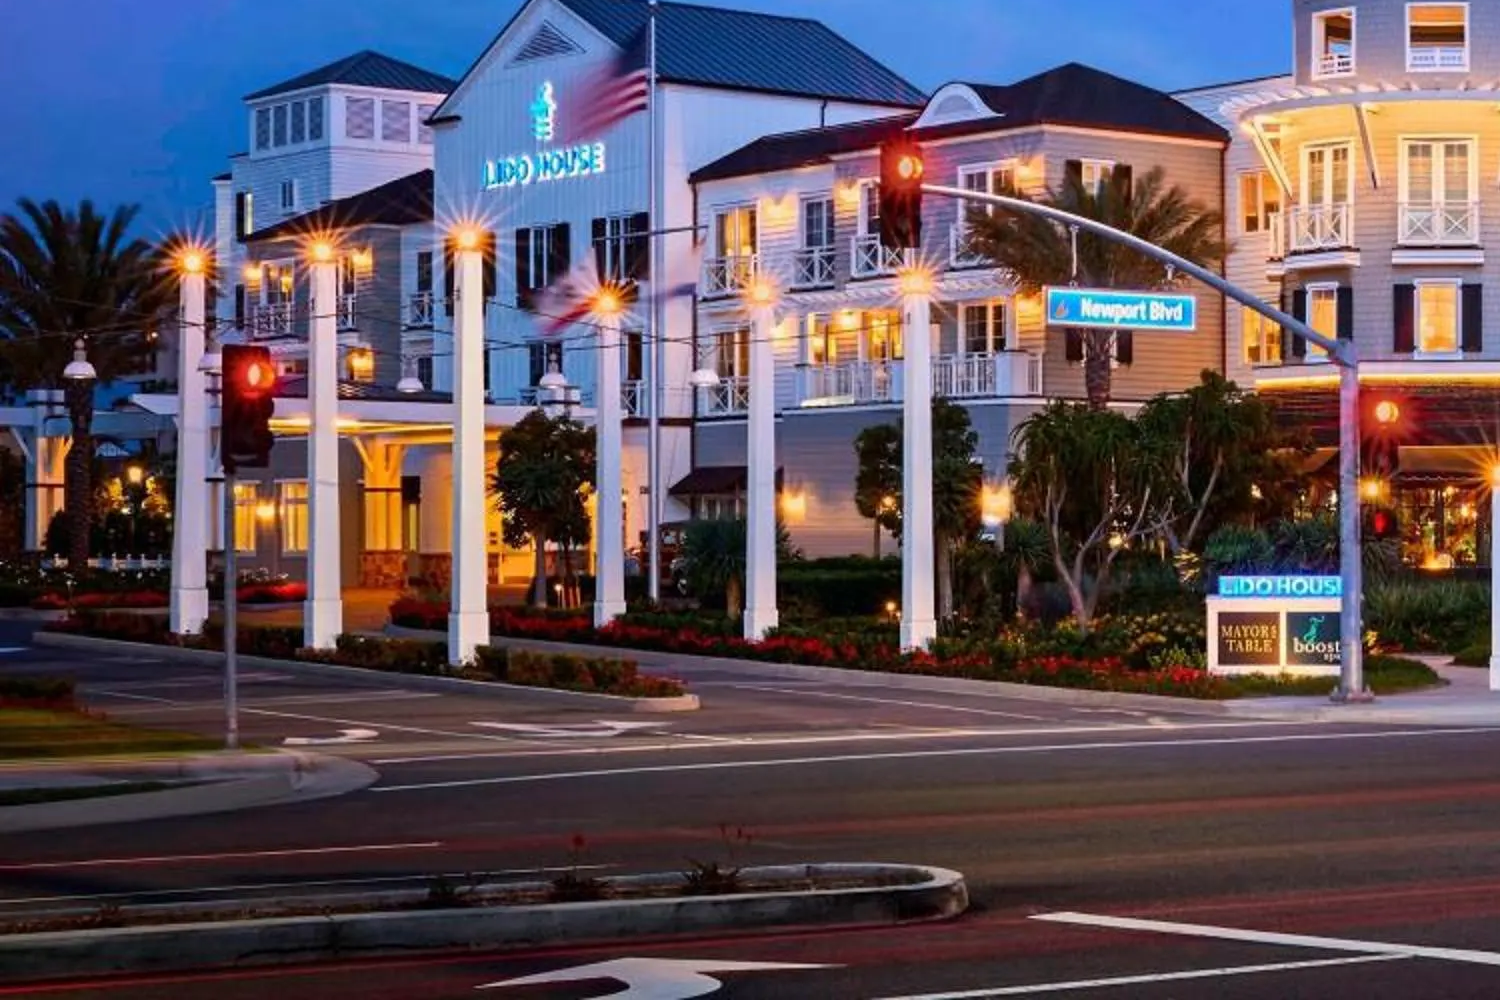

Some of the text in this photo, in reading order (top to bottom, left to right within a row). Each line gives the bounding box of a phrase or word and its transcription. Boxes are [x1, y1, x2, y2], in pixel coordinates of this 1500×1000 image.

[482, 142, 606, 189] LIDO HOUSE
[1080, 298, 1184, 324] Newport Blvd
[1219, 576, 1274, 595] LIDO
[1225, 639, 1274, 654] TABLE
